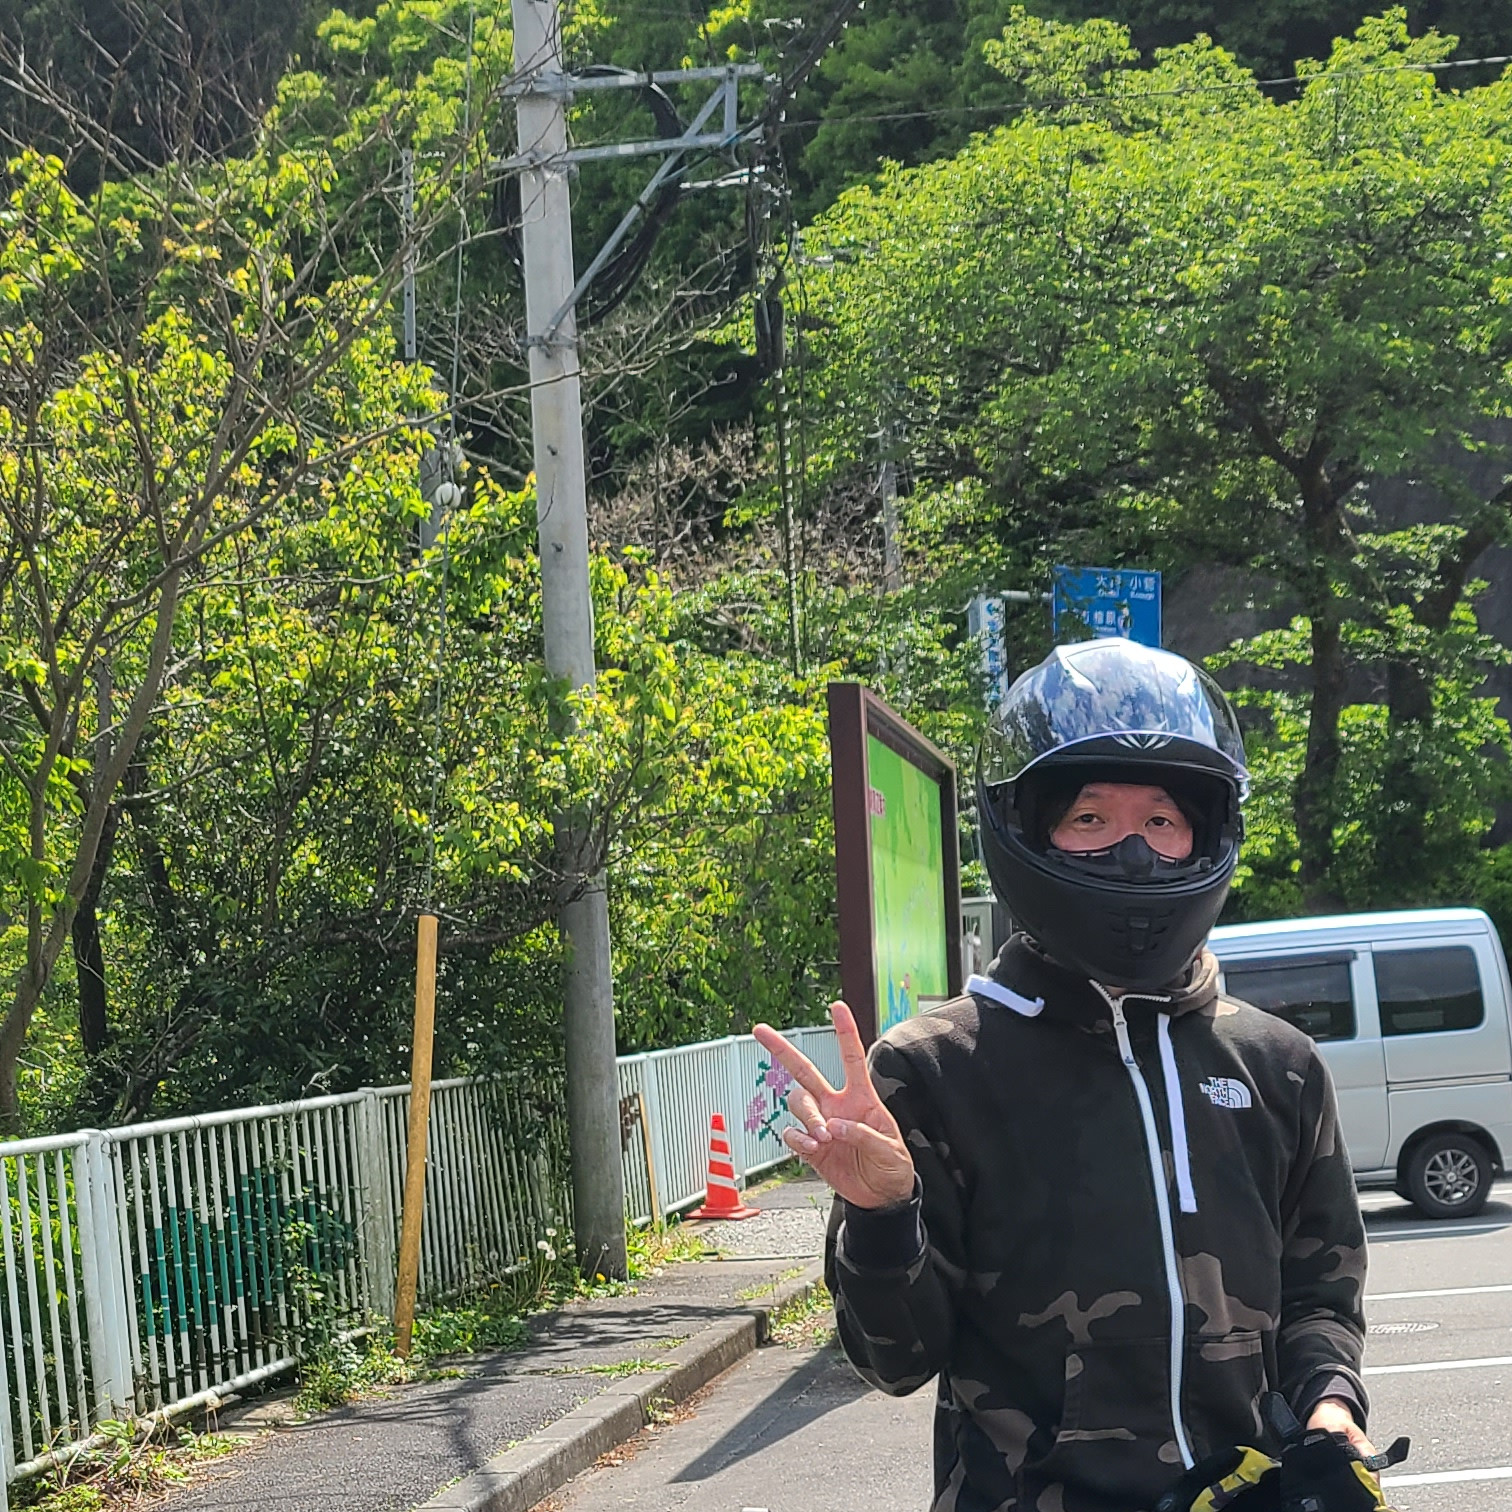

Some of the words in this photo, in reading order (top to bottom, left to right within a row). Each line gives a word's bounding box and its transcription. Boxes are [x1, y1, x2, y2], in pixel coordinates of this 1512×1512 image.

[1207, 1076, 1228, 1088] THE
[1198, 1083, 1228, 1099] NORTH
[1210, 1094, 1230, 1107] FACE
